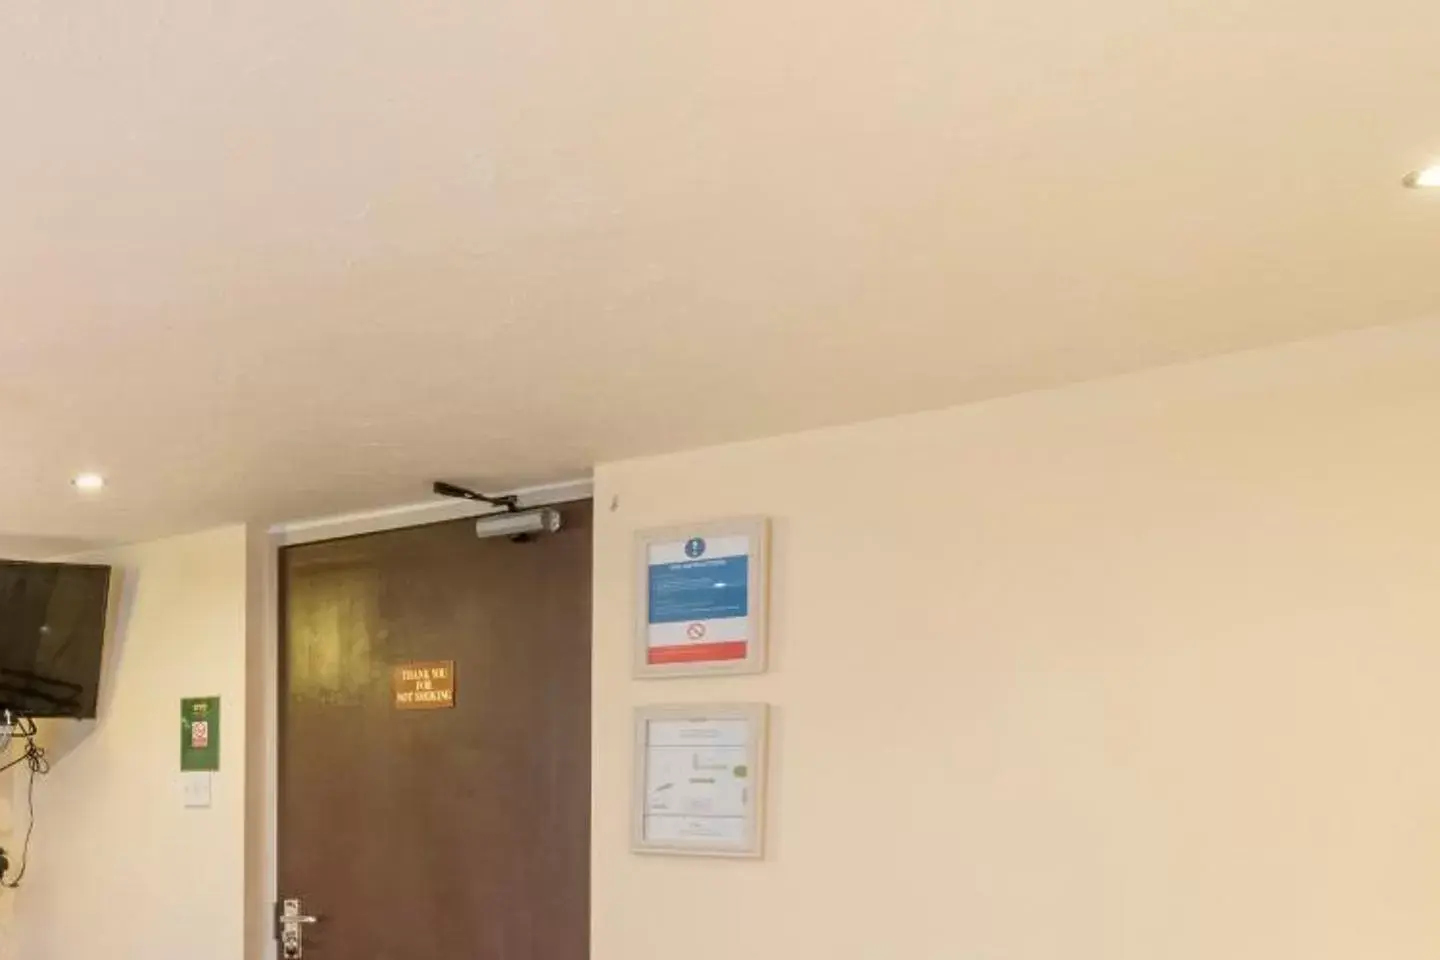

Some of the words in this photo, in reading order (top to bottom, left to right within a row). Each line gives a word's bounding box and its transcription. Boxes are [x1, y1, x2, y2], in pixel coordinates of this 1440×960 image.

[403, 669, 430, 680] THANK
[432, 668, 448, 679] YOU
[416, 680, 432, 690] FOR
[397, 693, 413, 702] NOT
[414, 691, 452, 702] SMOKING
